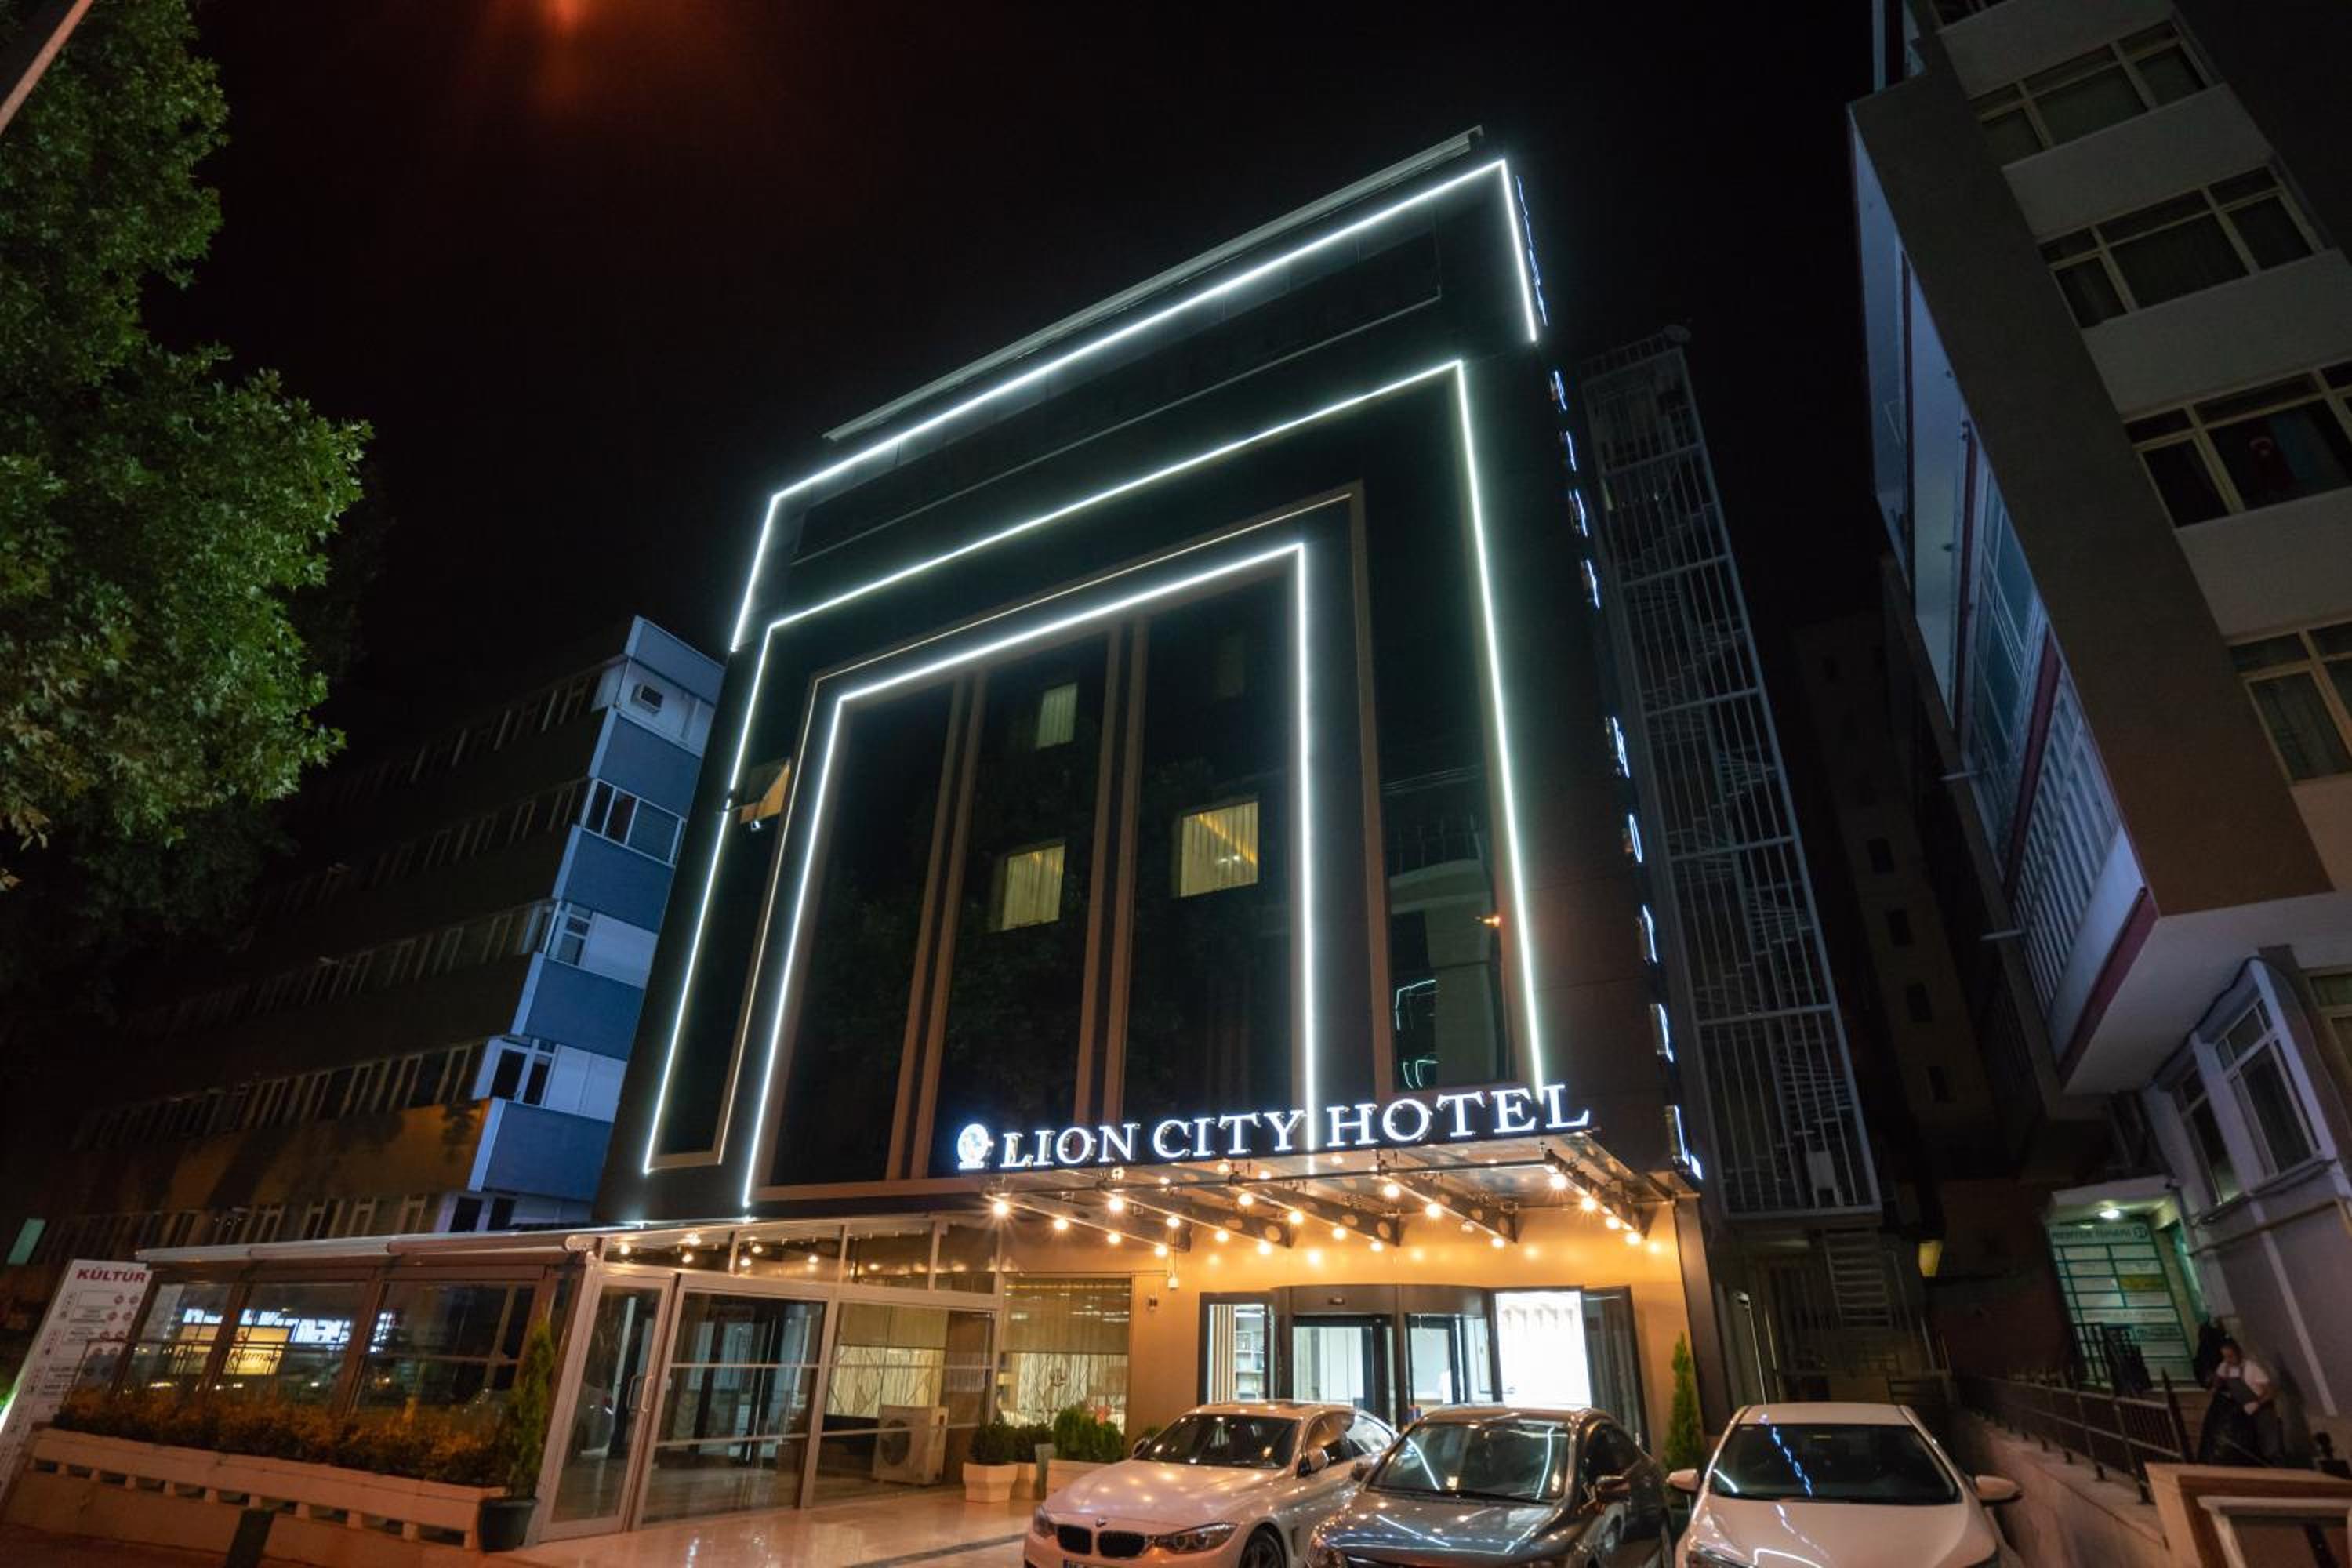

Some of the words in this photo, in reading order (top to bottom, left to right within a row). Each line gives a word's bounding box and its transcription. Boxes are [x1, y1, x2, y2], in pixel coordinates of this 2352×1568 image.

[1000, 1123, 1138, 1168] LION
[1153, 1109, 1305, 1159] CITY
[1327, 1083, 1589, 1147] HOTEL
